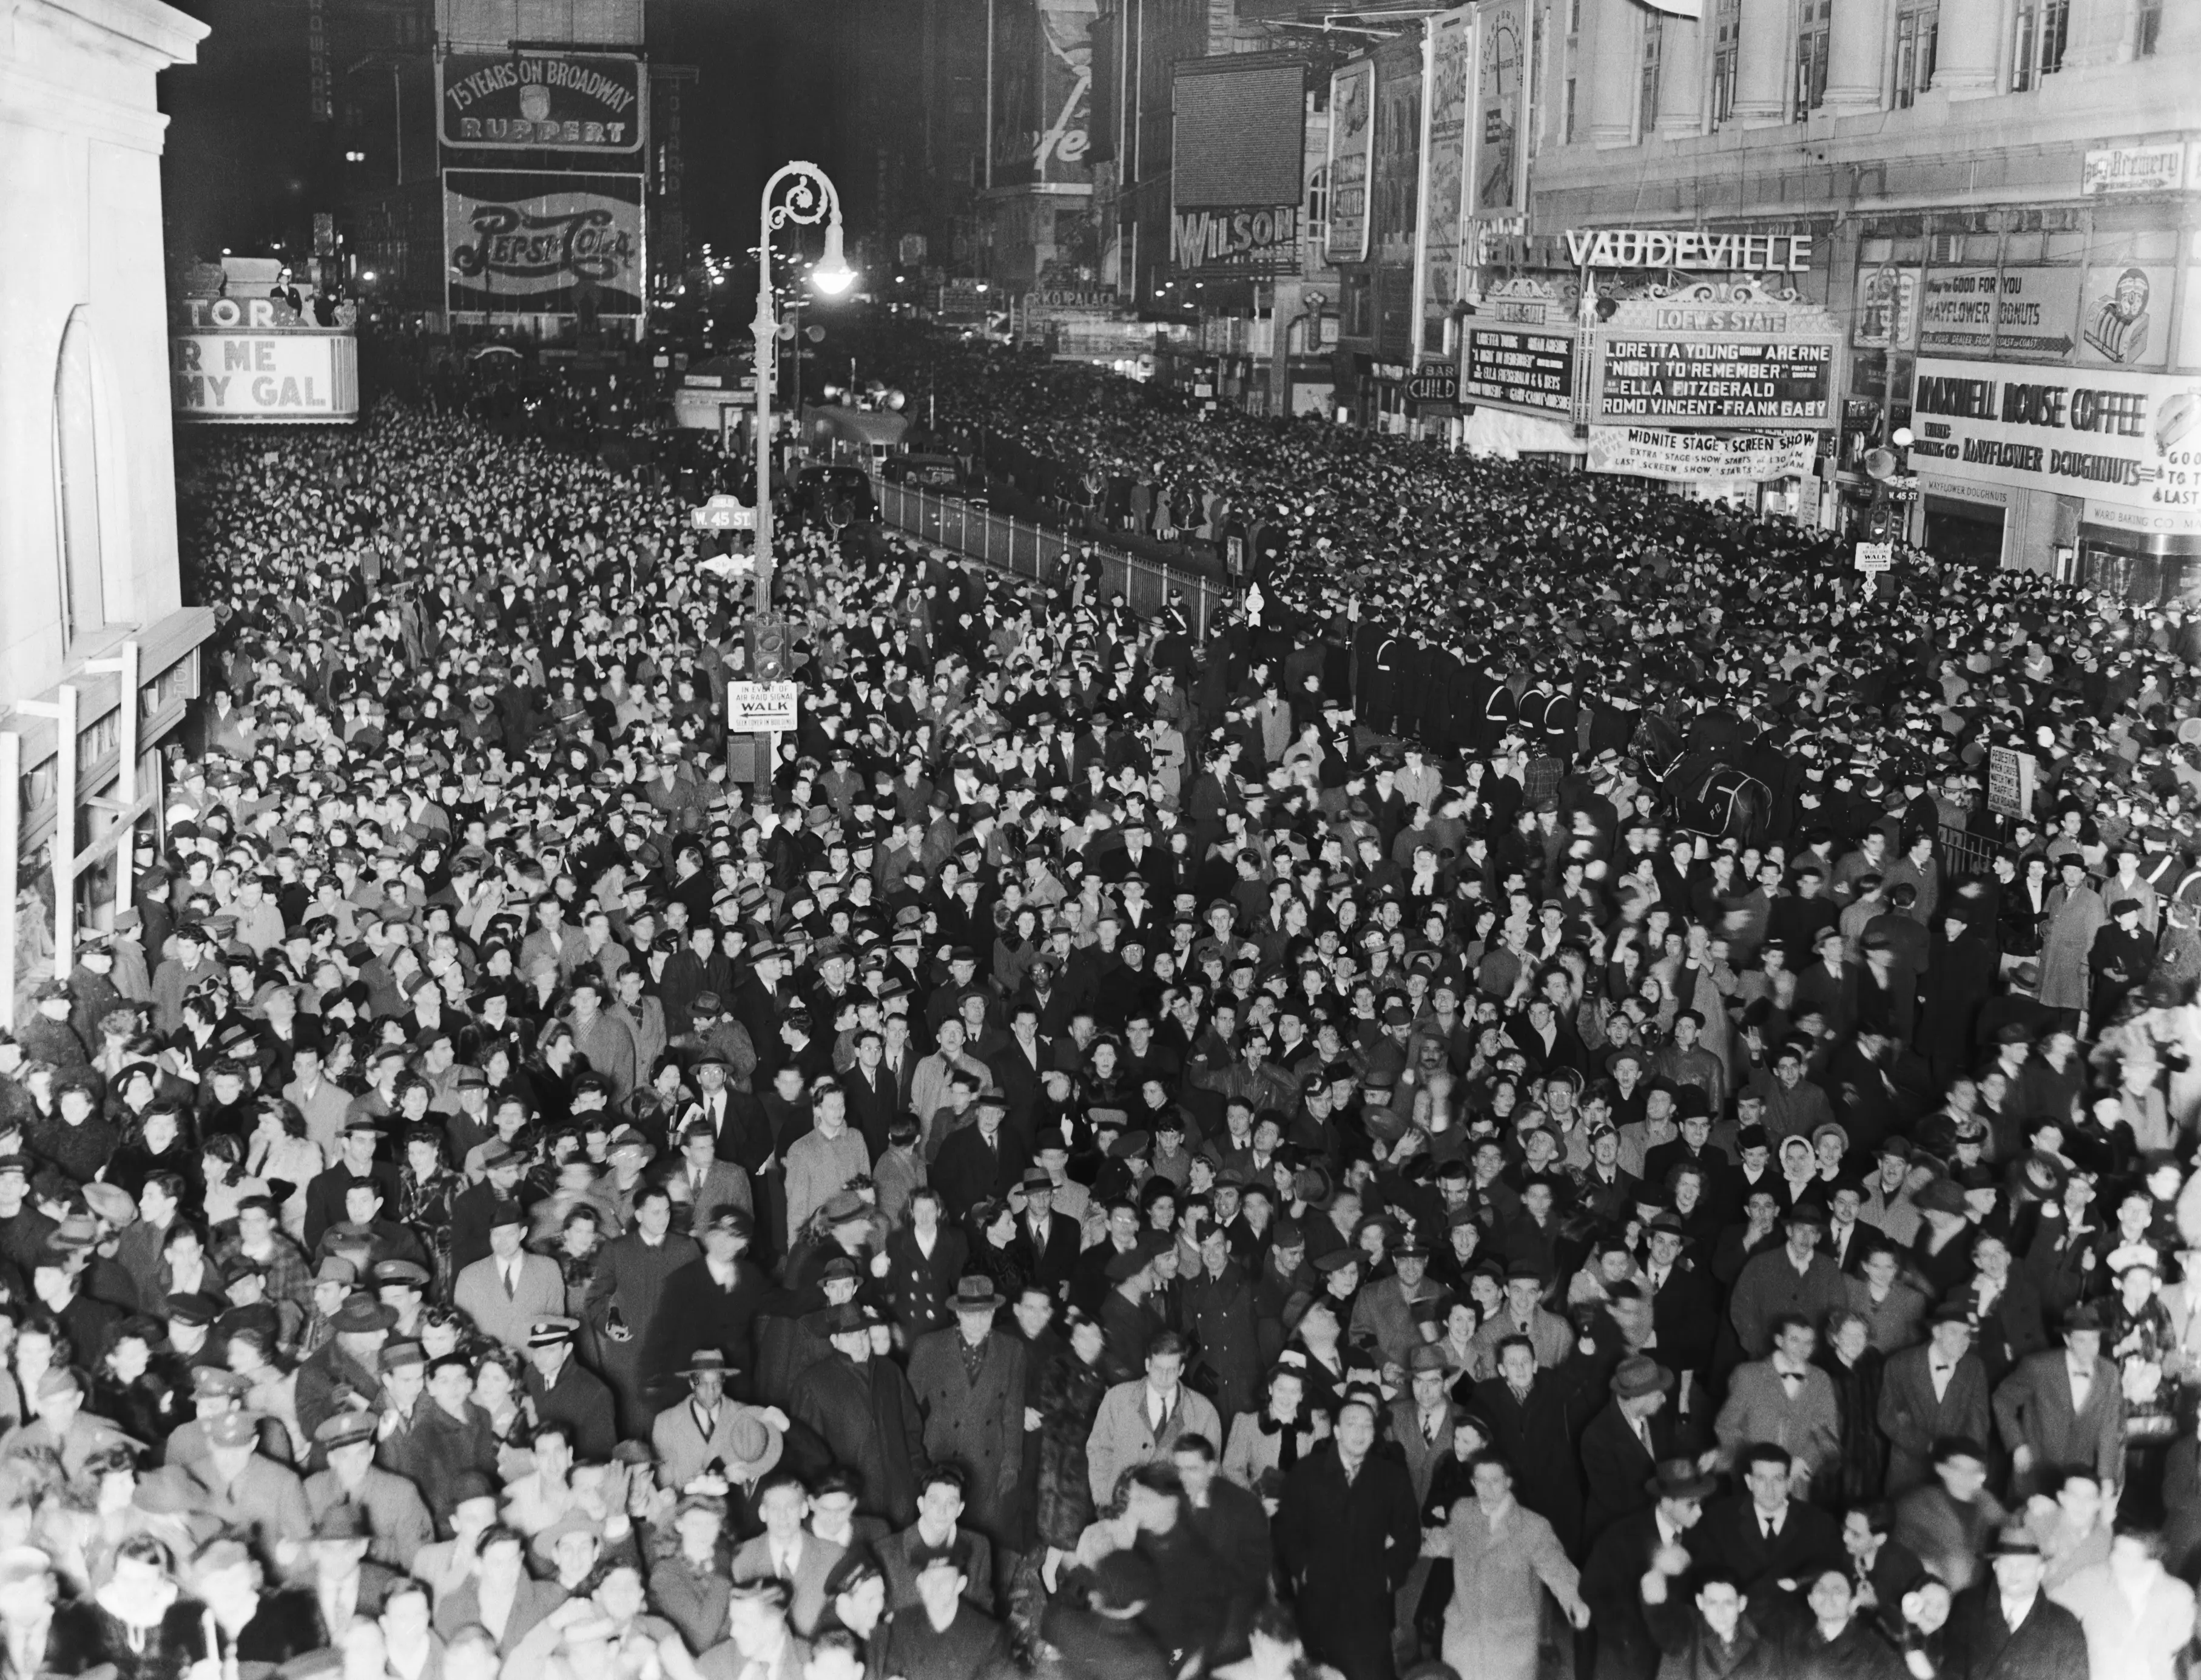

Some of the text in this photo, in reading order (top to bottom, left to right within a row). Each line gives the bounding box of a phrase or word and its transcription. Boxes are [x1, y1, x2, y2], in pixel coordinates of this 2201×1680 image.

[446, 60, 634, 113] 75 YEARS ON BROADWAY
[461, 118, 626, 143] RUPPERT
[1175, 209, 1295, 270] WILSON
[1566, 230, 1812, 272] VAUDEVILLE
[1953, 277, 1975, 294] GOOD
[1978, 277, 1996, 294] FOR
[2003, 277, 2022, 294] YOU
[1032, 291, 1061, 306] RKO
[1657, 309, 1787, 332] LOEW'S STATE
[1924, 301, 2040, 325] MAYFLOWER DONUTS
[1935, 334, 1949, 343] YOUR
[1951, 334, 1973, 344] DEALER
[1975, 335, 1990, 345] FROM
[1996, 337, 2014, 347] COAST
[2019, 339, 2037, 348] COAST
[224, 340, 277, 372] ME
[1605, 342, 1680, 359] LORETTA
[1685, 344, 1738, 360] YOUNG
[1766, 346, 1830, 362] AHERNE
[1426, 365, 1454, 376] BAR
[1666, 362, 1686, 378] TO
[178, 376, 326, 408] MY GAL
[1409, 379, 1456, 399] CHILD
[1620, 380, 1663, 396] ELLA
[1673, 382, 1775, 397] FITZGERALD
[1602, 398, 1646, 414] ROMO
[1781, 400, 1826, 417] GABY
[1915, 375, 2148, 438] MAXWELL HOUSE COFFEE
[1924, 421, 1951, 439] WARD
[1628, 429, 1677, 449] MIDNITE
[1683, 436, 1719, 451] STAGE
[1732, 437, 1775, 453] SCREEN
[1779, 433, 1815, 450] SHOW
[1630, 448, 1657, 459] EXTRA
[1665, 452, 1691, 462] STAGE
[1695, 456, 1721, 464] SHOW
[1725, 456, 1751, 465] STARTS
[1913, 437, 2142, 487] BAKING CO MAYFLOWER DOUGHNUTS
[1614, 458, 1636, 467] LAST
[1643, 462, 1677, 473] SCREEN
[1684, 466, 1711, 474] SHOW
[1719, 466, 1752, 476] STARTS
[2168, 471, 2185, 486] TO
[1896, 492, 1907, 501] 45
[1908, 492, 1918, 501] ST.
[1929, 480, 2007, 503] MAYFLOWER DOUGHNUTS
[2164, 490, 2199, 505] LAST
[695, 511, 751, 527] W. 45 ST.
[2094, 507, 2116, 522] WARD
[2118, 512, 2149, 527] BAKING
[2154, 518, 2174, 529] CO
[770, 693, 794, 701] SIGNAL
[741, 702, 788, 711] WALK
[1990, 763, 2003, 772] WHEN
[1990, 782, 2014, 798] TRAFFIC
